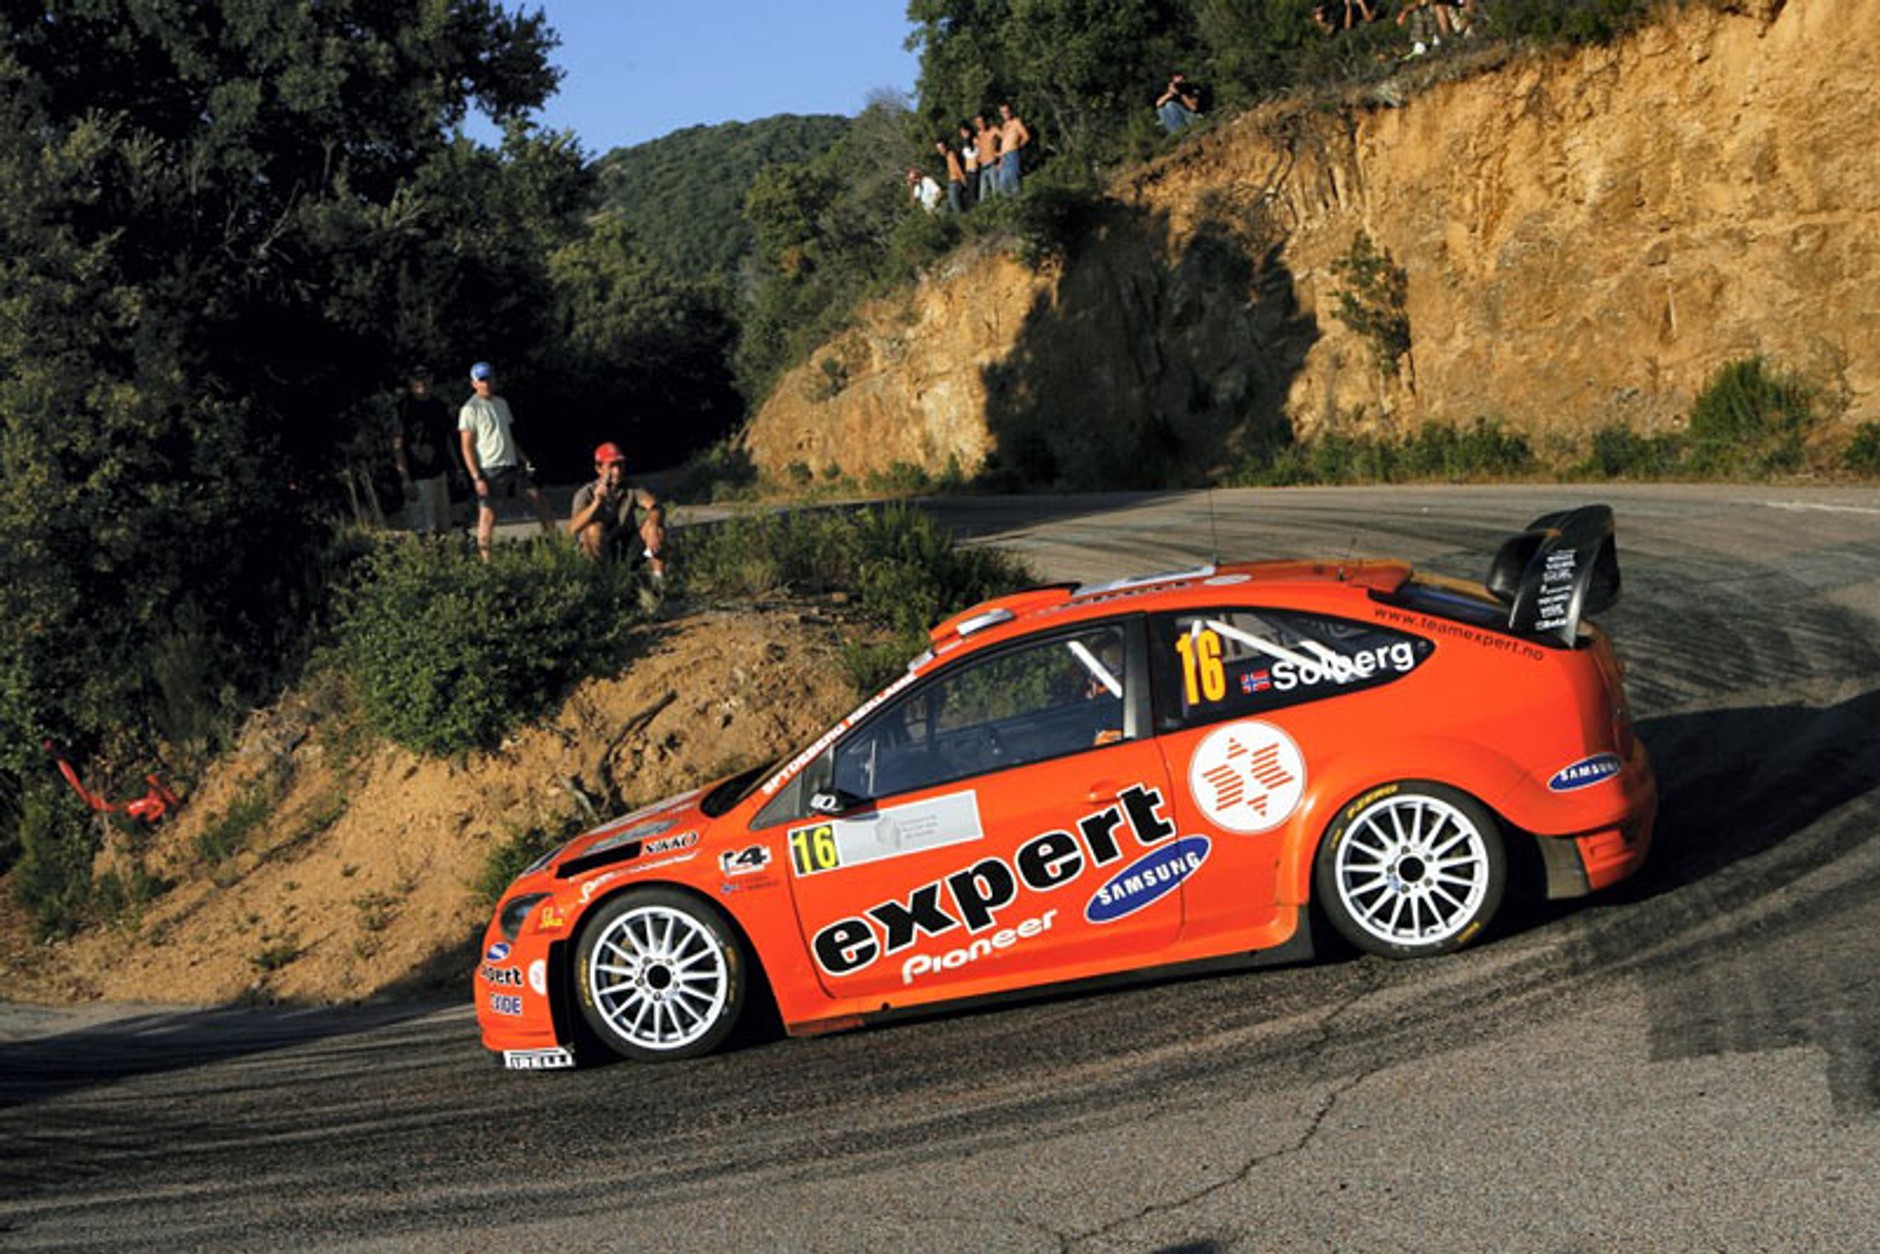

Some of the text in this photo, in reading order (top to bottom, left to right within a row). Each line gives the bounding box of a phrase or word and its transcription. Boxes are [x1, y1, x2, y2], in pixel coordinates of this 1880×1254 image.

[1374, 607, 1544, 662] www.teamexpert.no
[1175, 629, 1226, 706] 16
[1271, 641, 1415, 690] Solberg
[792, 825, 837, 875] 16
[812, 782, 1176, 976] expert
[1098, 852, 1201, 905] SAMSUNG
[902, 908, 1058, 985] Pioneer
